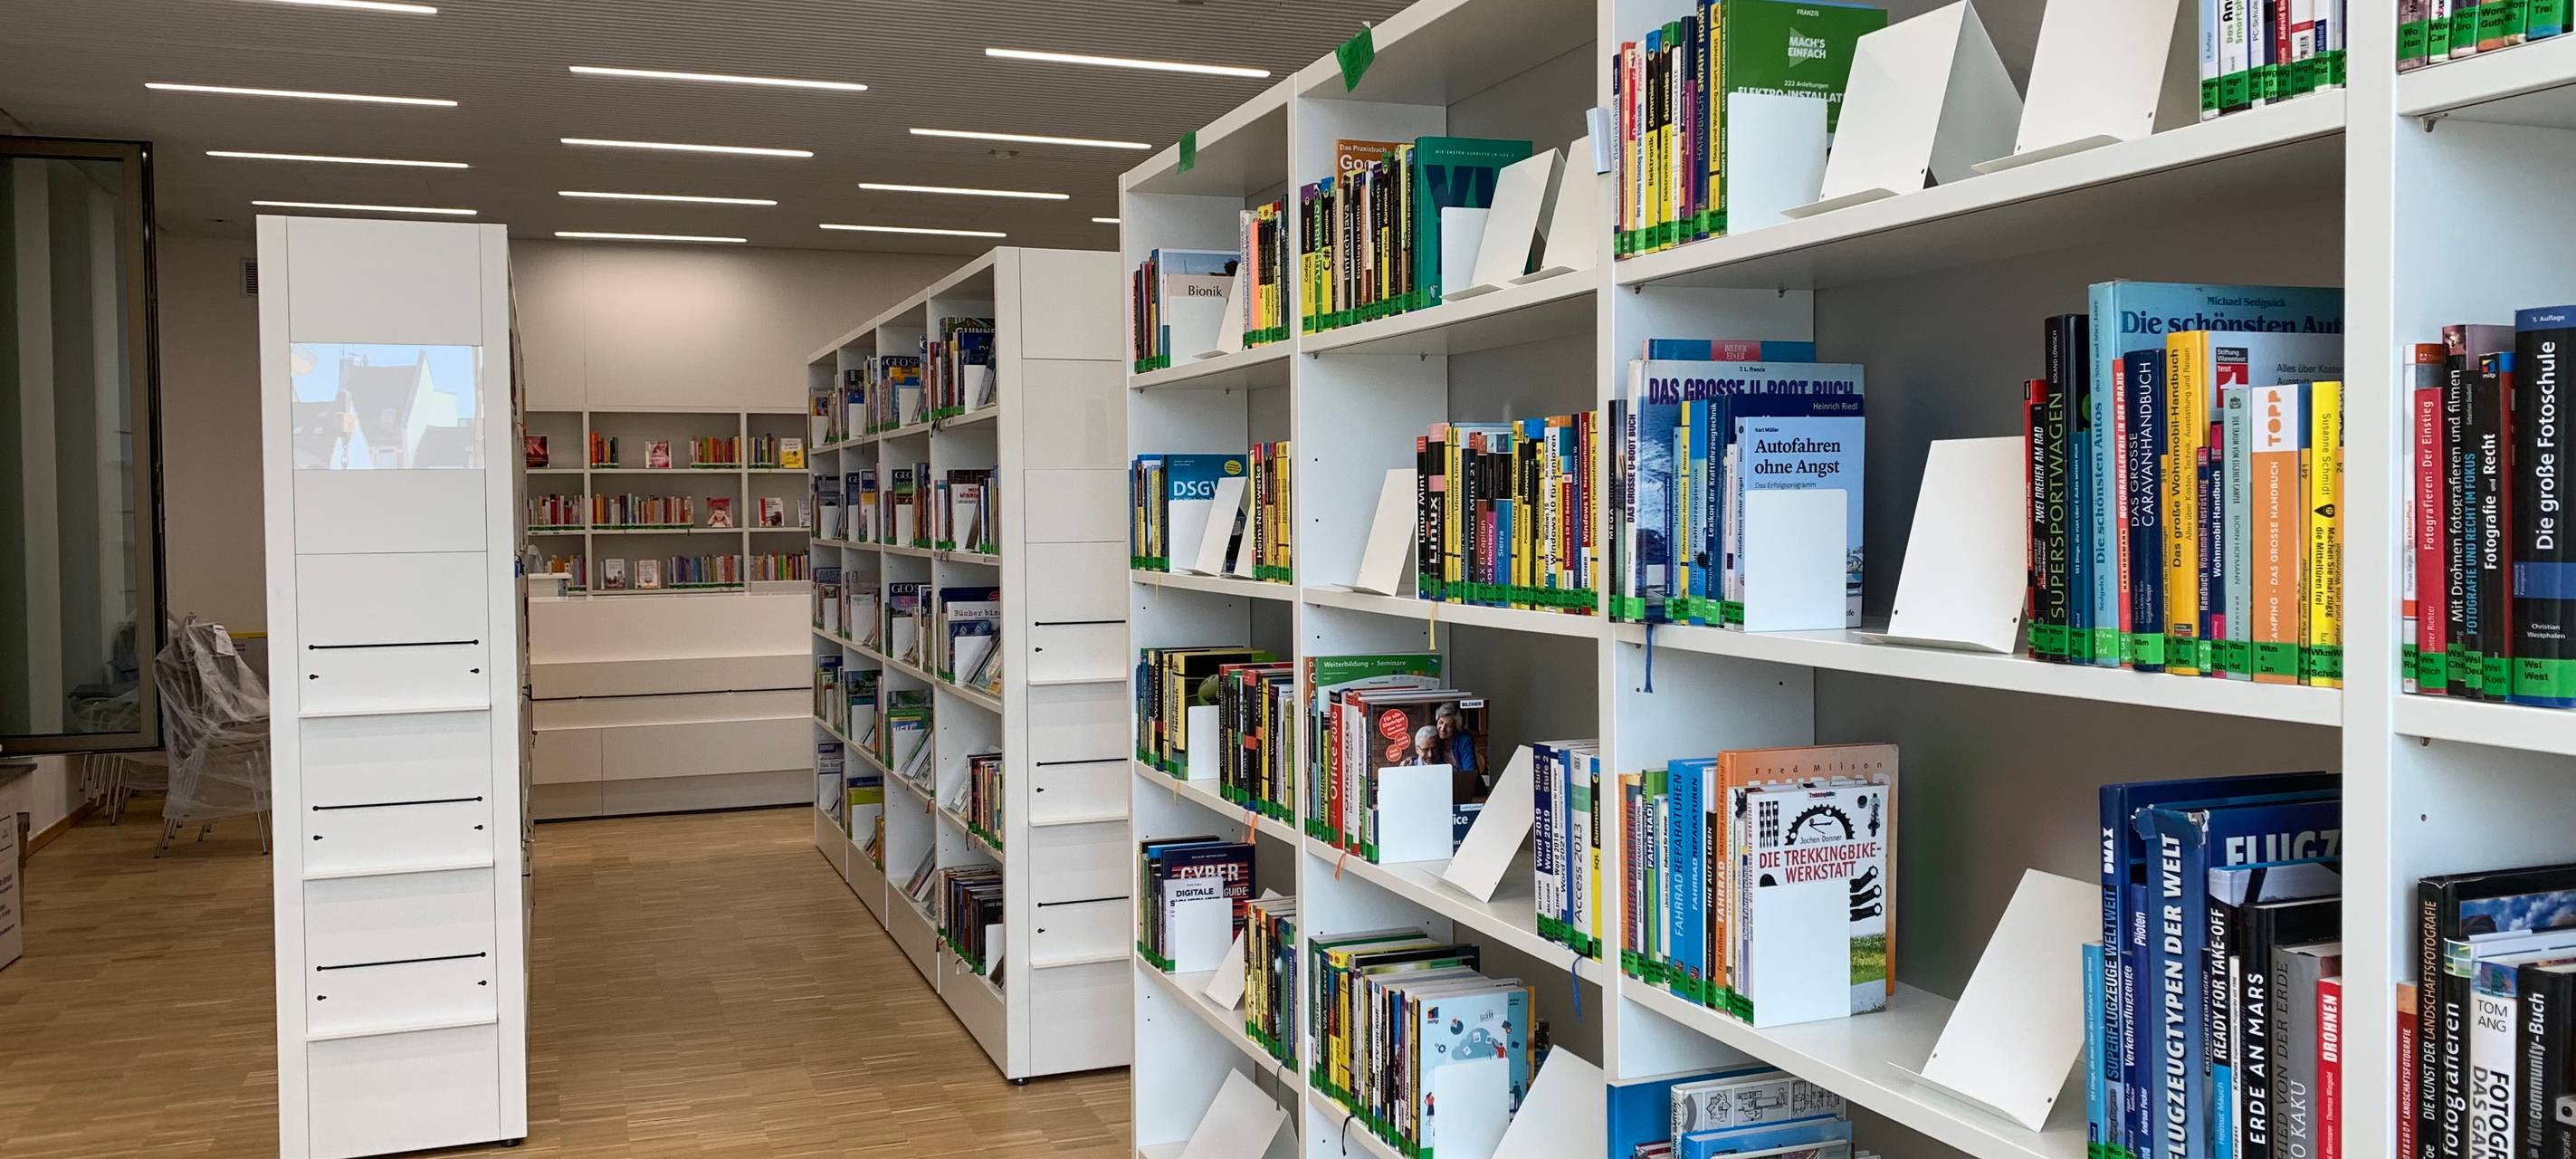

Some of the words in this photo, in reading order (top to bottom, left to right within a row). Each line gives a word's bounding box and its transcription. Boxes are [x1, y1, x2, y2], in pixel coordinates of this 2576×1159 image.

[1696, 3, 1706, 43] HOME
[1797, 8, 1819, 16] FRANZIS
[1788, 47, 1827, 59] EINFACH
[1789, 36, 1826, 48] MACH'S
[2404, 40, 2421, 48] Han
[1697, 47, 1705, 92] SMART
[1696, 95, 1704, 160] HANDBUCH
[1352, 145, 1388, 153] Praxisbuch
[1322, 249, 1331, 271] C#
[1188, 284, 1223, 297] Bionik
[2207, 296, 2242, 306] Michael
[2243, 297, 2286, 309] Sedgwick
[2121, 311, 2162, 334] Die
[2167, 311, 2295, 333] schönsten
[2539, 314, 2565, 323] Auflage
[2217, 350, 2239, 358] Stiftung
[1813, 402, 1840, 410] Heinrich
[1841, 402, 1858, 410] Riedl
[2447, 369, 2460, 413] filmen
[2536, 341, 2555, 447] Fotoschule
[1627, 414, 1636, 437] BUCH
[2033, 426, 2044, 445] RAD
[2093, 403, 2104, 448] Autos
[2170, 350, 2181, 496] Wohnmobil-Handbuch
[2267, 388, 2282, 446] TOPP
[2321, 413, 2331, 454] Susanne
[2421, 401, 2434, 445] Einstieg
[2448, 416, 2461, 442] und
[1627, 439, 1636, 470] U-BOOT
[1709, 402, 1719, 486] Kraftfahrzeugtechnik
[1754, 438, 1841, 454] Autofahren
[2034, 446, 2045, 462] AM
[2139, 362, 2154, 527] CARAVAN-HANDBUCH
[2422, 447, 2432, 468] Der
[2480, 434, 2495, 474] Recht
[1469, 461, 1476, 476] 21
[1754, 459, 1793, 474] ohne
[1795, 459, 1840, 478] Angst
[2034, 464, 2046, 499] DREHEN
[2130, 433, 2140, 493] GROSSE
[2321, 455, 2331, 495] Schmidt
[2464, 453, 2476, 489] FOKUS
[1627, 472, 1636, 504] GROSSE
[2094, 453, 2105, 535] schönsten
[2448, 446, 2464, 534] fotografieren
[2465, 491, 2476, 503] IM
[2535, 454, 2559, 512] große
[1550, 501, 1557, 513] 10
[1627, 507, 1636, 523] DAS
[2035, 501, 2046, 524] ZWEI
[2048, 392, 2066, 619] SUPERSPORTWAGEN
[2131, 498, 2140, 527] DAS
[2172, 500, 2183, 539] große
[2199, 479, 2209, 569] Wohnmobil-Ausrüstung
[2212, 470, 2222, 578] Wohnmobil-Handbuch
[2423, 471, 2436, 551] Fotografieren:
[2465, 507, 2476, 541] RECHT
[1429, 496, 1438, 564] Linux
[1487, 522, 1495, 566] Monterey
[2483, 495, 2500, 570] Fotografie
[2536, 517, 2554, 550] Die
[2095, 539, 2106, 564] Die
[2172, 542, 2181, 568] Das
[2449, 538, 2462, 595] Drohnen
[2466, 543, 2476, 566] UND
[2199, 572, 2209, 611] Handbuch
[2466, 568, 2476, 635] FOTOGRAFIE
[2451, 599, 2463, 622] Mit
[2532, 622, 2561, 631] Christian
[2527, 630, 2566, 640] Westphalen
[1324, 659, 1369, 669] Weiterbildung
[1377, 658, 1407, 666] Seminare
[2524, 672, 2549, 681] West
[1330, 711, 1338, 742] 2016
[1330, 746, 1339, 800] Office
[1755, 765, 1798, 775] Fred
[1813, 761, 1883, 772] Milson
[1573, 823, 1582, 863] 2013
[1674, 773, 1684, 937] FAHRRADREPARATUREN
[1691, 778, 1699, 912] FAHRRADREPARATUREN
[1759, 851, 1780, 868] DIE
[1784, 842, 1882, 867] TREKKINGBIKE-
[1799, 836, 1820, 845] Jochen
[1821, 835, 1842, 843] Donner
[2103, 826, 2115, 874] DMAX
[1180, 862, 1239, 882] CYBER
[1785, 860, 1856, 884] WERKSTATT
[2161, 832, 2182, 898] WELT
[1176, 887, 1214, 897] DIGITALE
[1224, 886, 1249, 896] GUIDE
[1572, 867, 1583, 924] Access
[1716, 860, 1726, 924] FAHRRAD
[2104, 888, 2118, 956] WELTWEIT
[2133, 912, 2147, 946] Piloten
[2163, 905, 2183, 955] DER
[2209, 908, 2226, 976] TAKE-OFF
[2275, 961, 2289, 1014] ERDE
[2424, 900, 2437, 1040] LANDSCHAFTSFOTOGRAFIE
[2211, 980, 2227, 1010] FOR
[2247, 972, 2265, 1038] MARS
[2477, 999, 2508, 1016] TOM
[2104, 959, 2120, 1080] SUPERFLUGZEUGE
[2124, 965, 2134, 1068] Verkehrsflugzeuge
[2212, 1010, 2228, 1059] READY
[2322, 994, 2338, 1063] DROHNEN
[2477, 1016, 2506, 1033] ANG
[2275, 1020, 2289, 1059] DER
[2424, 1042, 2436, 1063] DER
[2248, 1045, 2265, 1078] AN
[2402, 1029, 2412, 1120] LANDSCHAFTSFOTOGRAFIE
[2442, 1002, 2466, 1157] fotografieren
[2526, 992, 2546, 1147] fotocommunity-Buch
[2275, 1066, 2289, 1106] VON
[2423, 1064, 2436, 1101] KUNST
[2249, 1087, 2266, 1145] ERDE
[2290, 1079, 2306, 1140] KAKU
[2423, 1103, 2436, 1121] DIE
